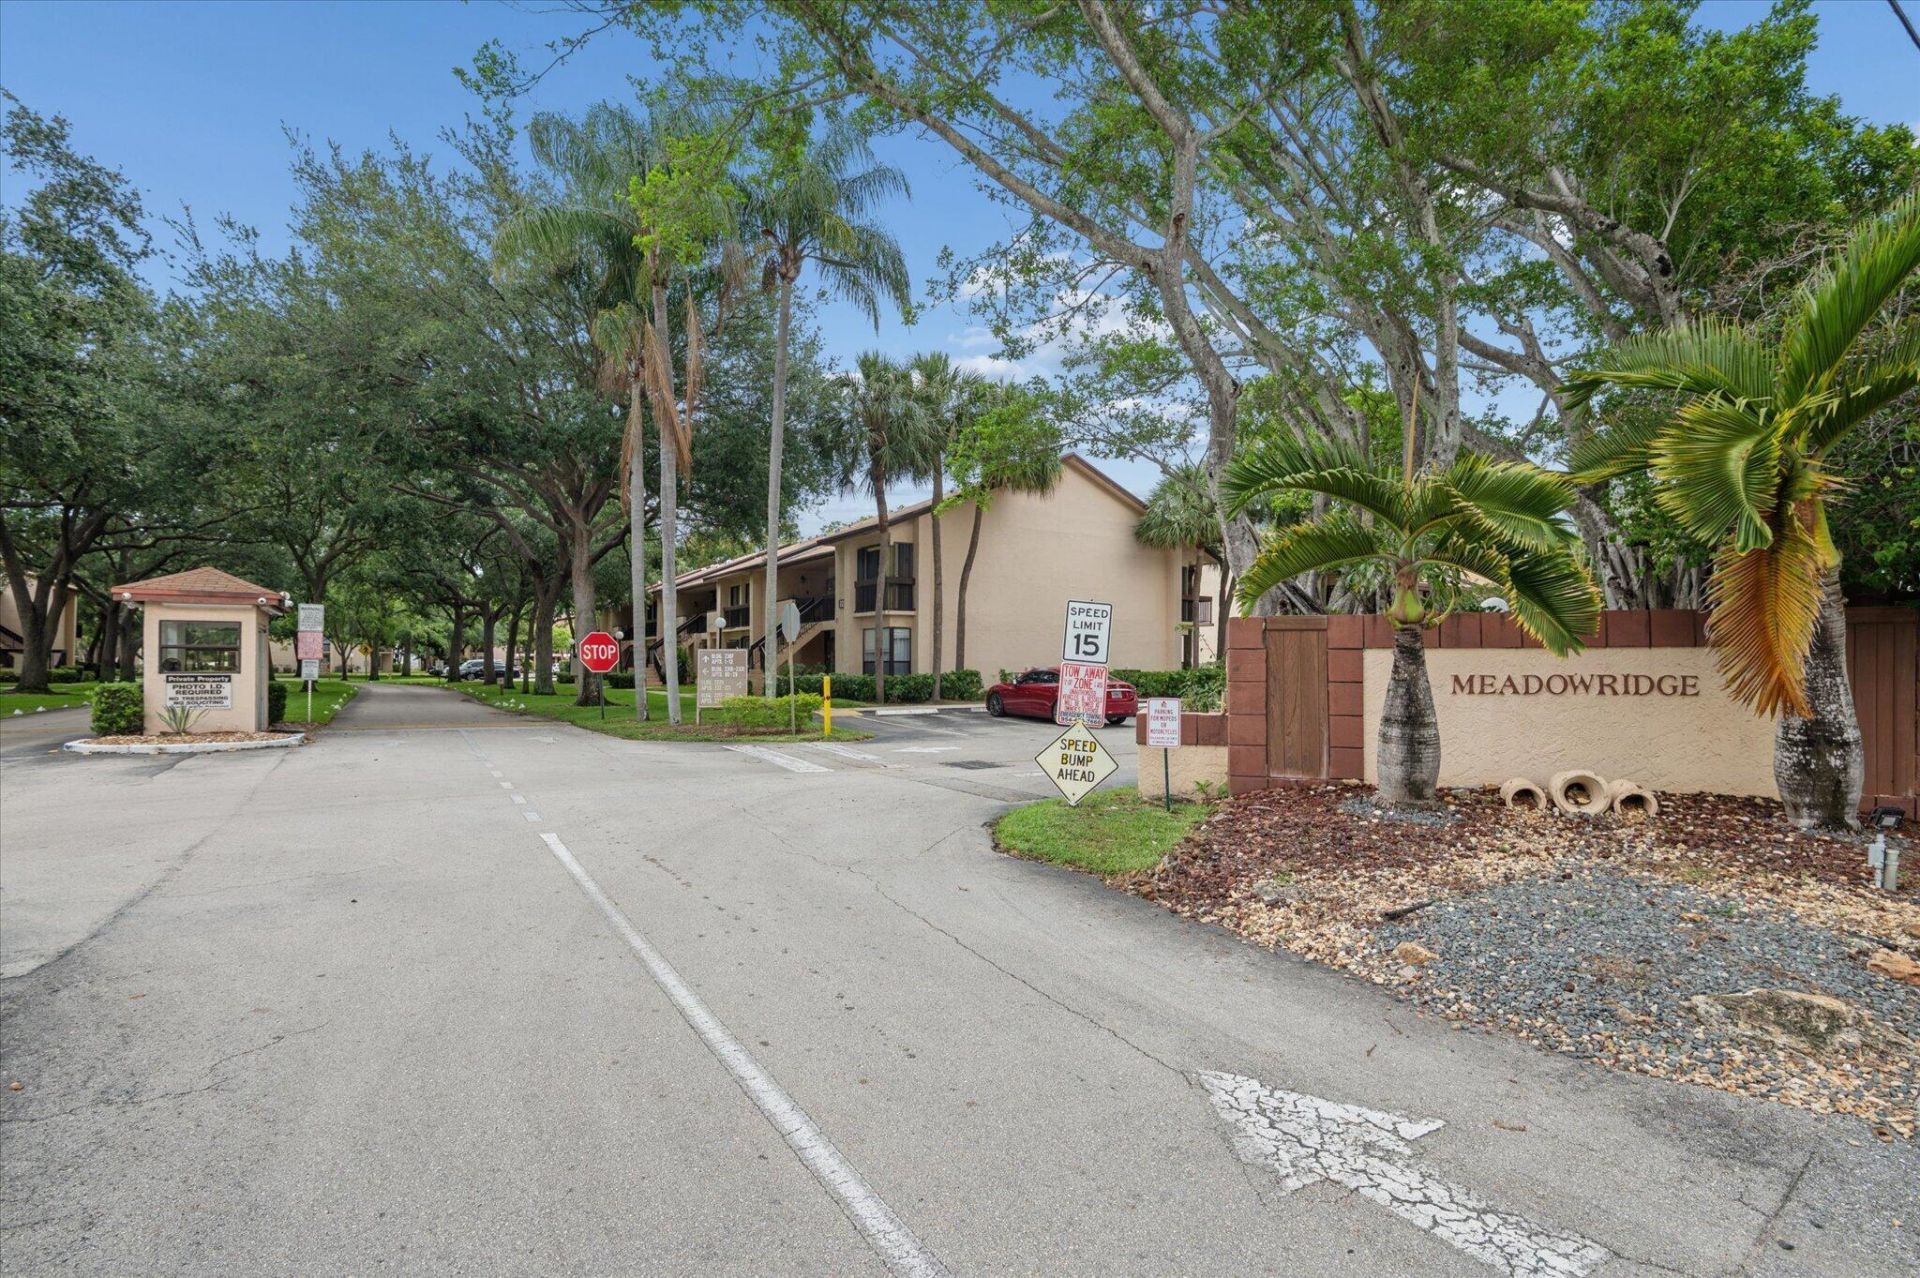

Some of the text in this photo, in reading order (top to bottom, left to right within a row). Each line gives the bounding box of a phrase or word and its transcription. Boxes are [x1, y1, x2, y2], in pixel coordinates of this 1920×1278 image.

[1070, 607, 1108, 618] SPEED
[1073, 620, 1103, 631] LIMIT
[1074, 633, 1099, 656] 15
[583, 644, 616, 660] STOP
[1064, 666, 1105, 679] TOW AWAY
[1074, 678, 1093, 689] ZONE
[1450, 673, 1700, 697] MEADOWRIDGE
[1060, 738, 1097, 753] SPEED
[1061, 753, 1093, 767] BUMP
[1057, 768, 1095, 782] AHEAD
